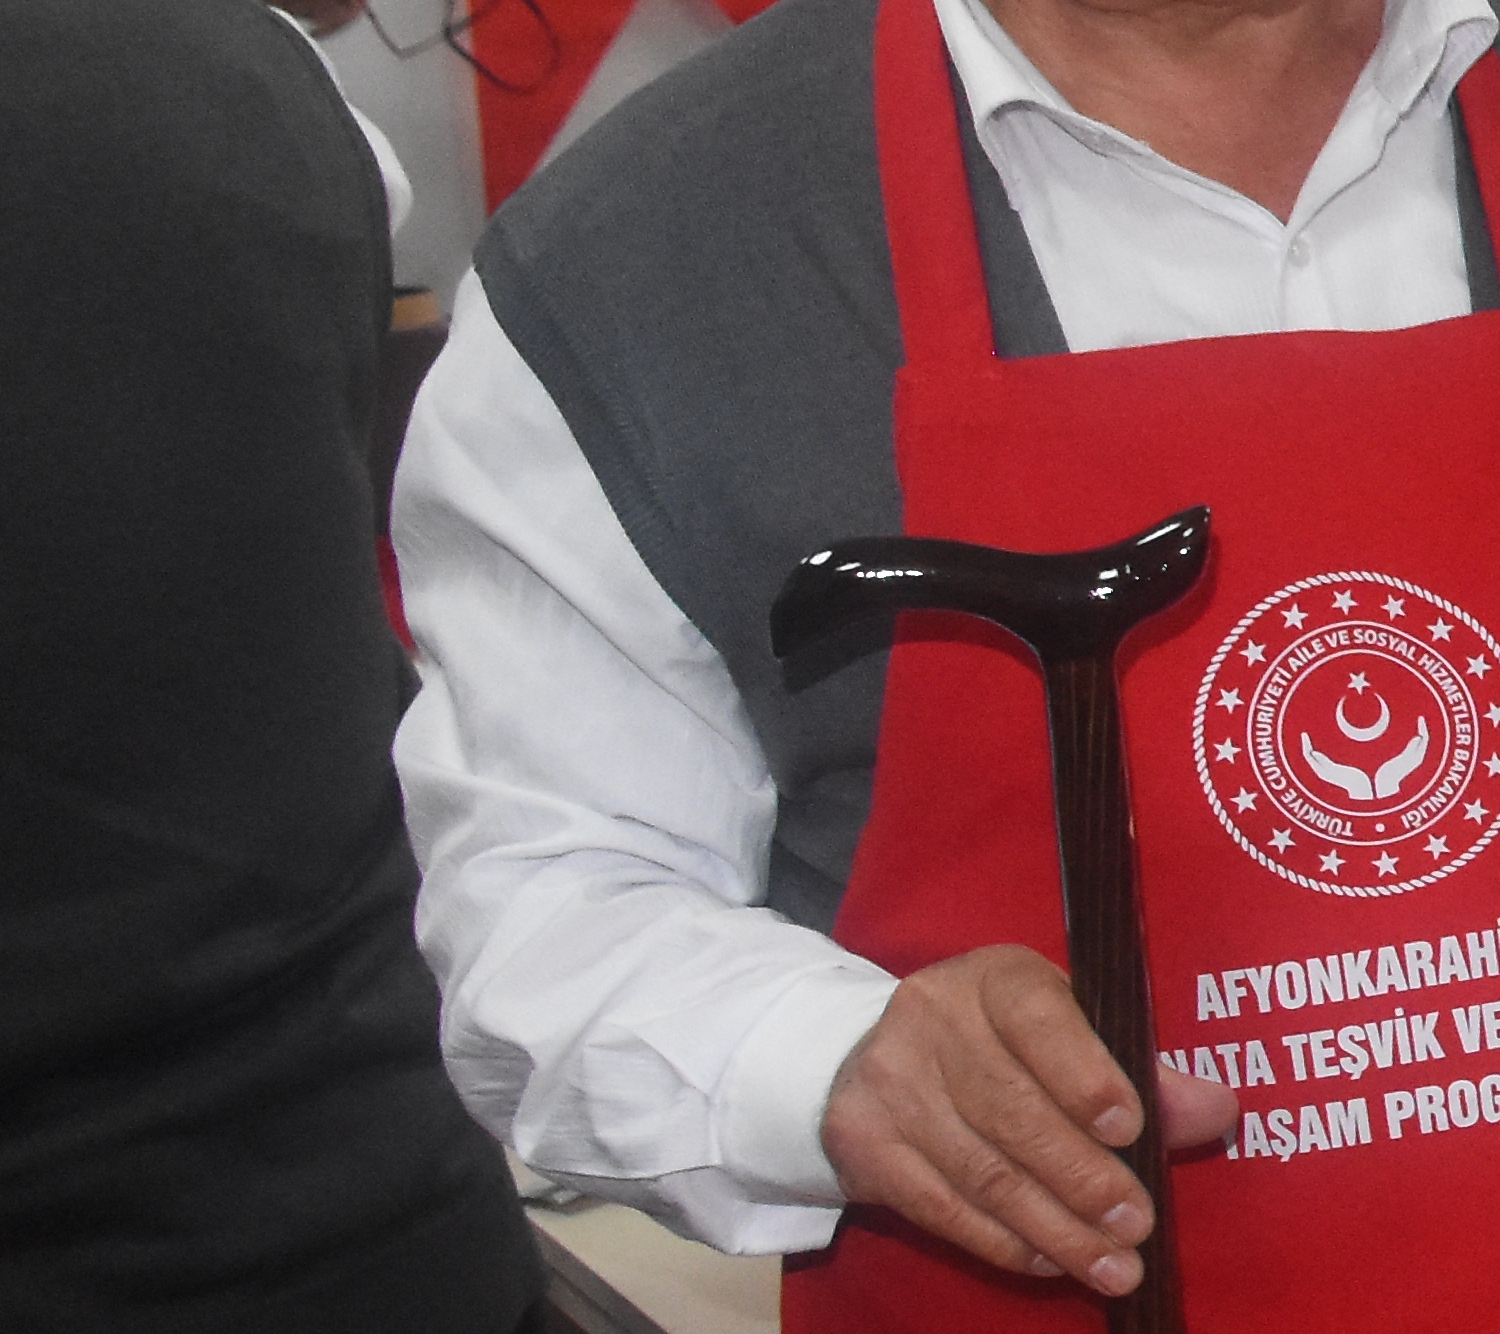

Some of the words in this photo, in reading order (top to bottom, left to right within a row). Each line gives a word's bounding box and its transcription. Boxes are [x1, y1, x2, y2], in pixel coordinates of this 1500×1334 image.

[1288, 640, 1326, 672] AİLE
[1325, 629, 1350, 649] VE
[1353, 628, 1417, 661] SOSYAL
[1256, 666, 1293, 791] CUMHURİYETİ
[1418, 656, 1472, 746] HİZMETLER
[1281, 788, 1354, 837] TÜRKİYE
[1400, 749, 1471, 829] BAKANLIĞI
[1282, 1007, 1446, 1080] TEŞVİK
